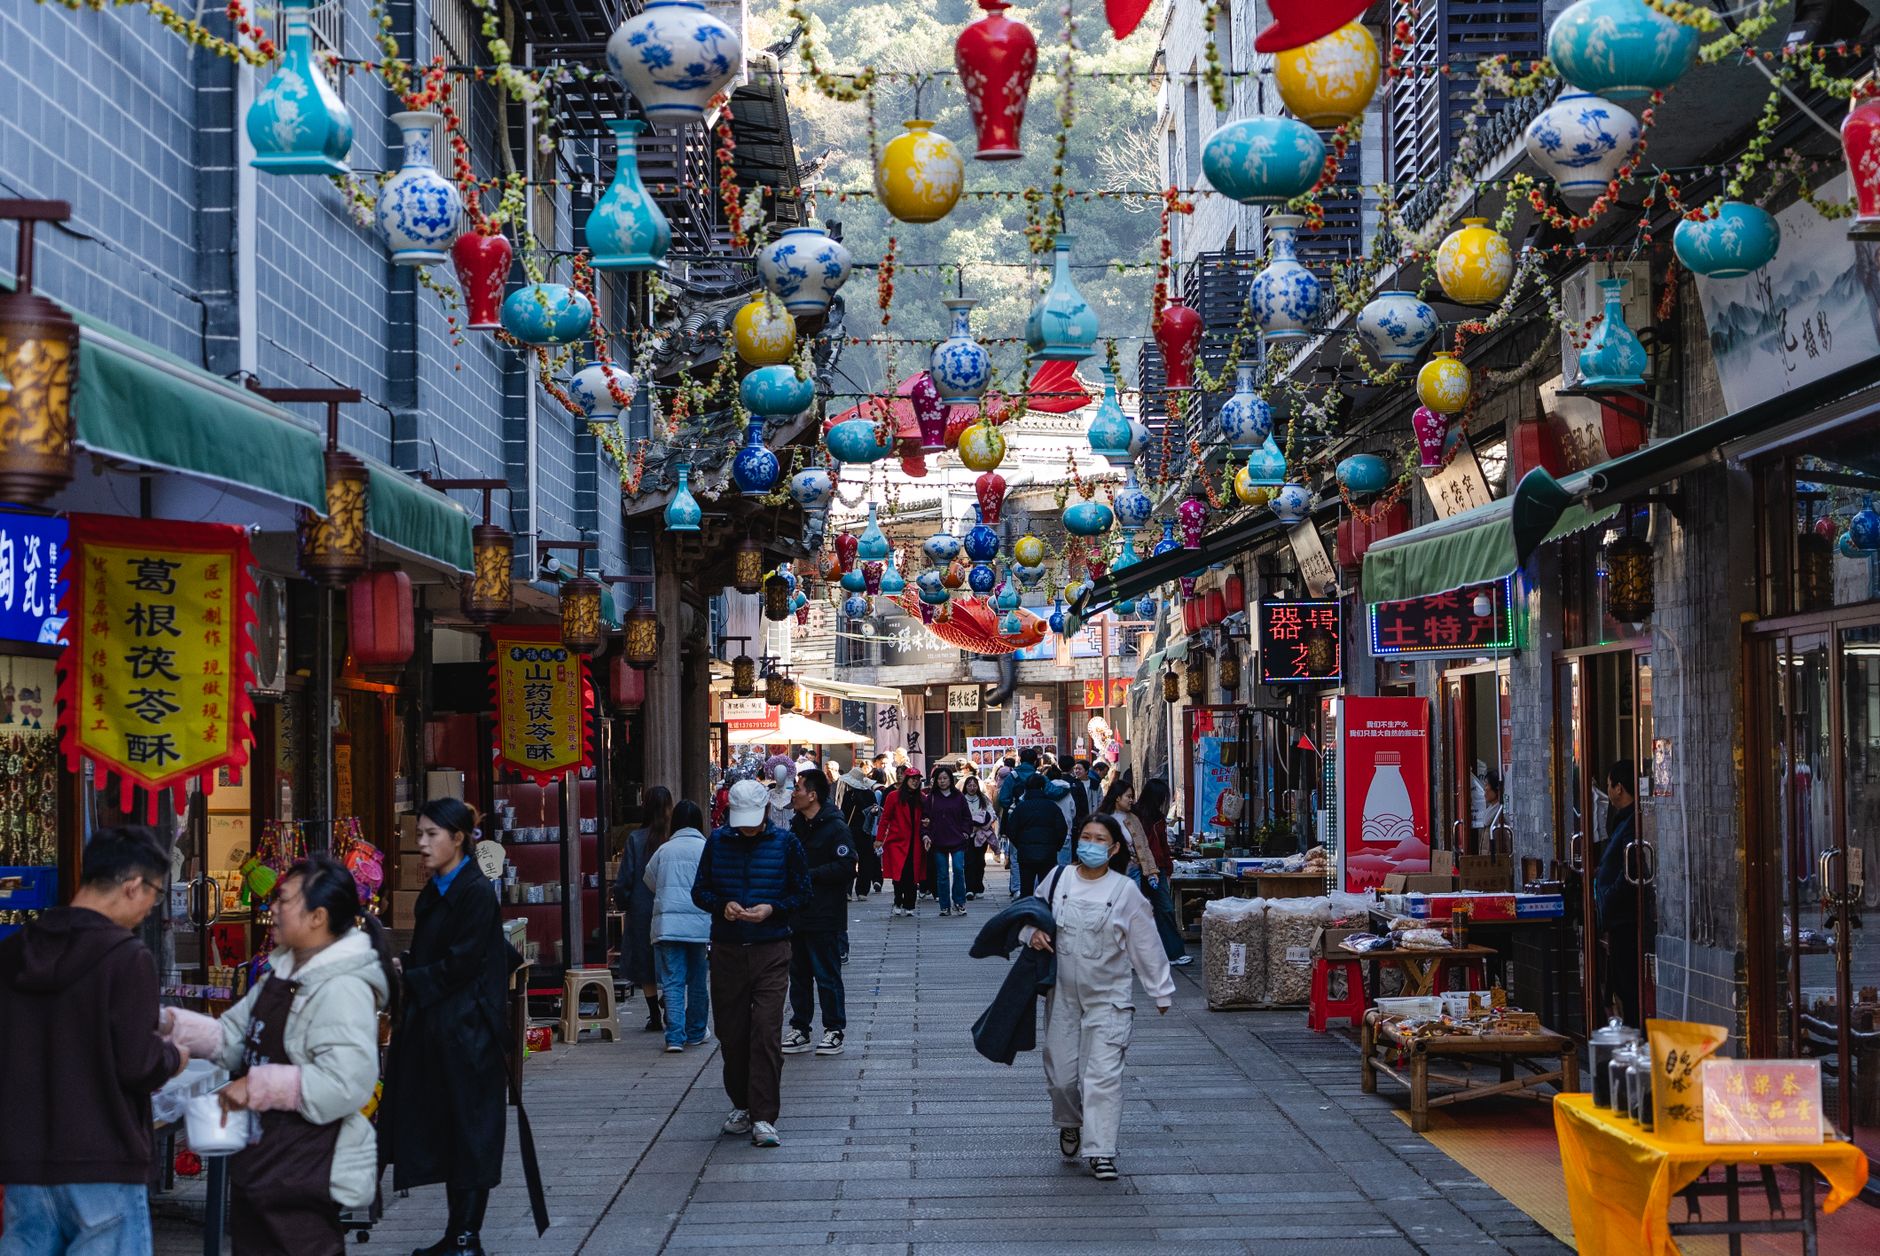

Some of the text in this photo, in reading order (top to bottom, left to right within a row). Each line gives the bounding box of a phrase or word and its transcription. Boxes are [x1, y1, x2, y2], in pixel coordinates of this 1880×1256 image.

[124, 556, 182, 767] 葛根茯苓酥
[202, 563, 223, 744] 匠心制作 现做现卖
[1381, 615, 1503, 646] 土特产
[523, 663, 556, 762] 山药茯苓酥
[1349, 729, 1426, 737] 我们只是大自然的搬运工
[1366, 720, 1409, 729] 我们不生产水
